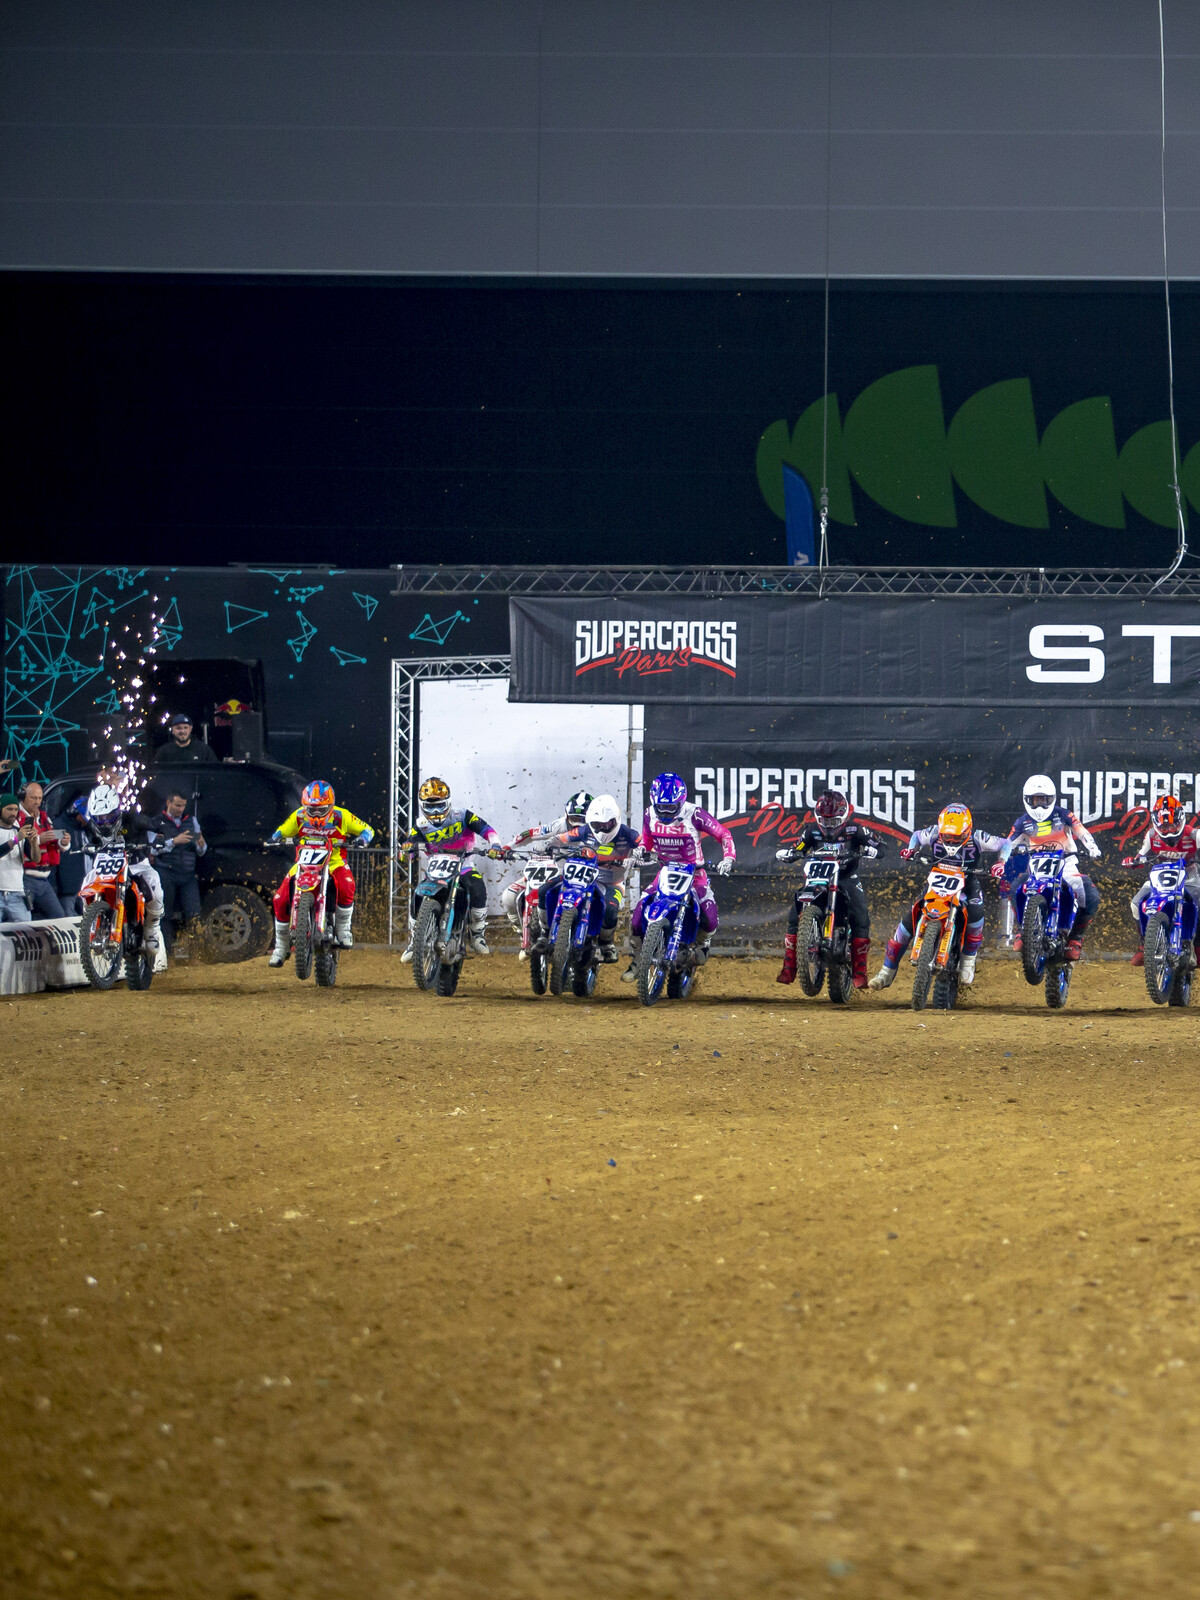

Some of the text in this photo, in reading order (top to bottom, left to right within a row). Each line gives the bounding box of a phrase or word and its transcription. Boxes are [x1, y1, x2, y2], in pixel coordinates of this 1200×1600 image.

[576, 620, 737, 669] SUPERCROSS
[614, 646, 693, 679] Paris
[694, 767, 915, 833] SUPERCROSS
[299, 849, 329, 864] 87
[934, 843, 976, 860] FR
[96, 859, 124, 875] 589
[427, 860, 460, 873] 848
[525, 867, 559, 882] 747
[564, 865, 598, 883] 945
[809, 863, 836, 879] 80
[1032, 859, 1061, 876] 141
[931, 875, 960, 890] 20
[1158, 870, 1179, 887] 6
